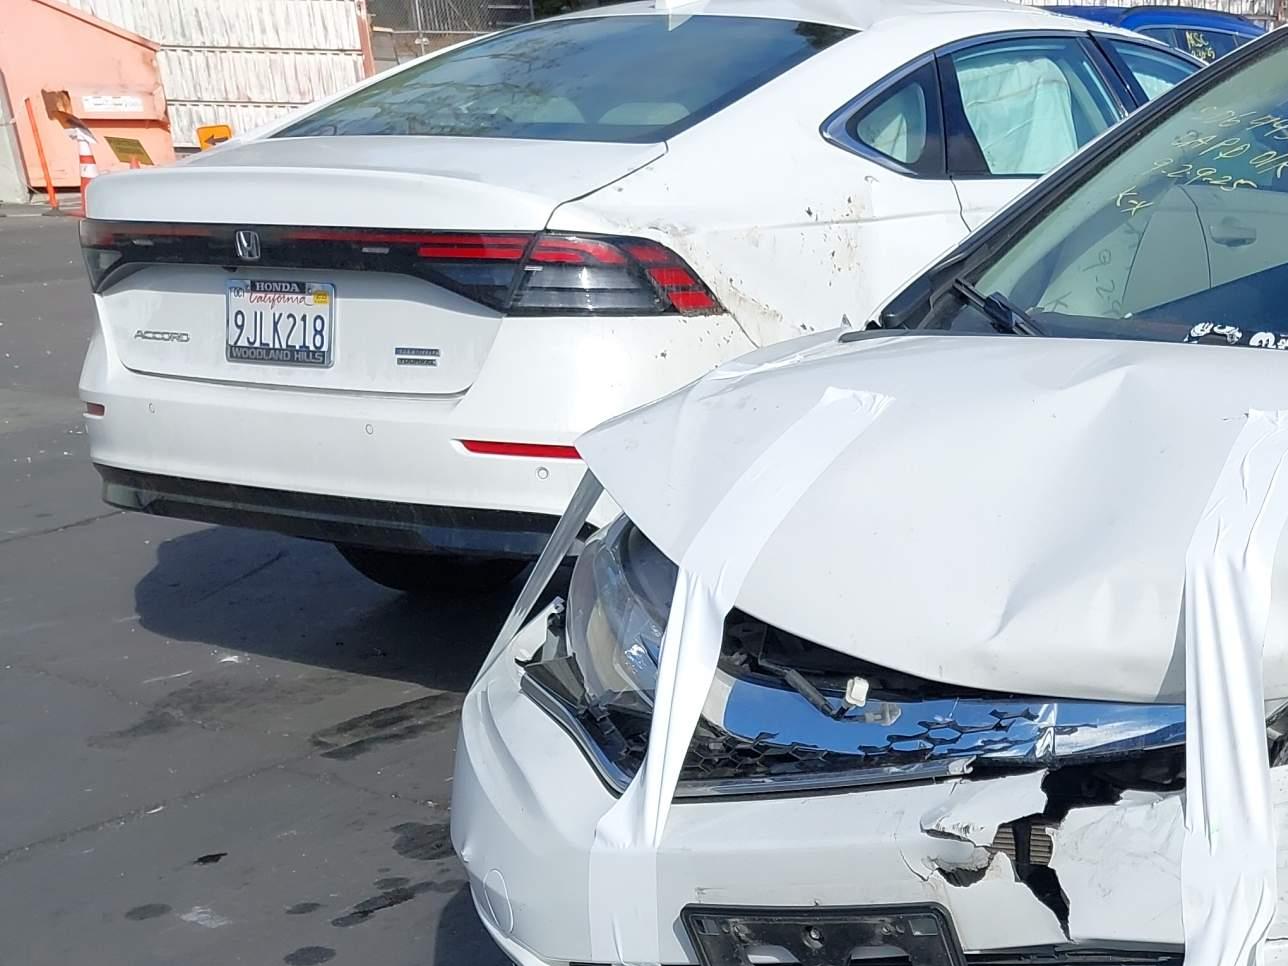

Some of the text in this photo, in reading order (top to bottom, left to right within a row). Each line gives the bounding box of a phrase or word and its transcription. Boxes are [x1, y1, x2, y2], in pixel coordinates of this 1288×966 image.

[256, 282, 299, 292] HONDA
[134, 330, 190, 342] ACCORD
[233, 310, 325, 351] 9JLK218
[232, 348, 323, 363] WOODLAND HILLS
